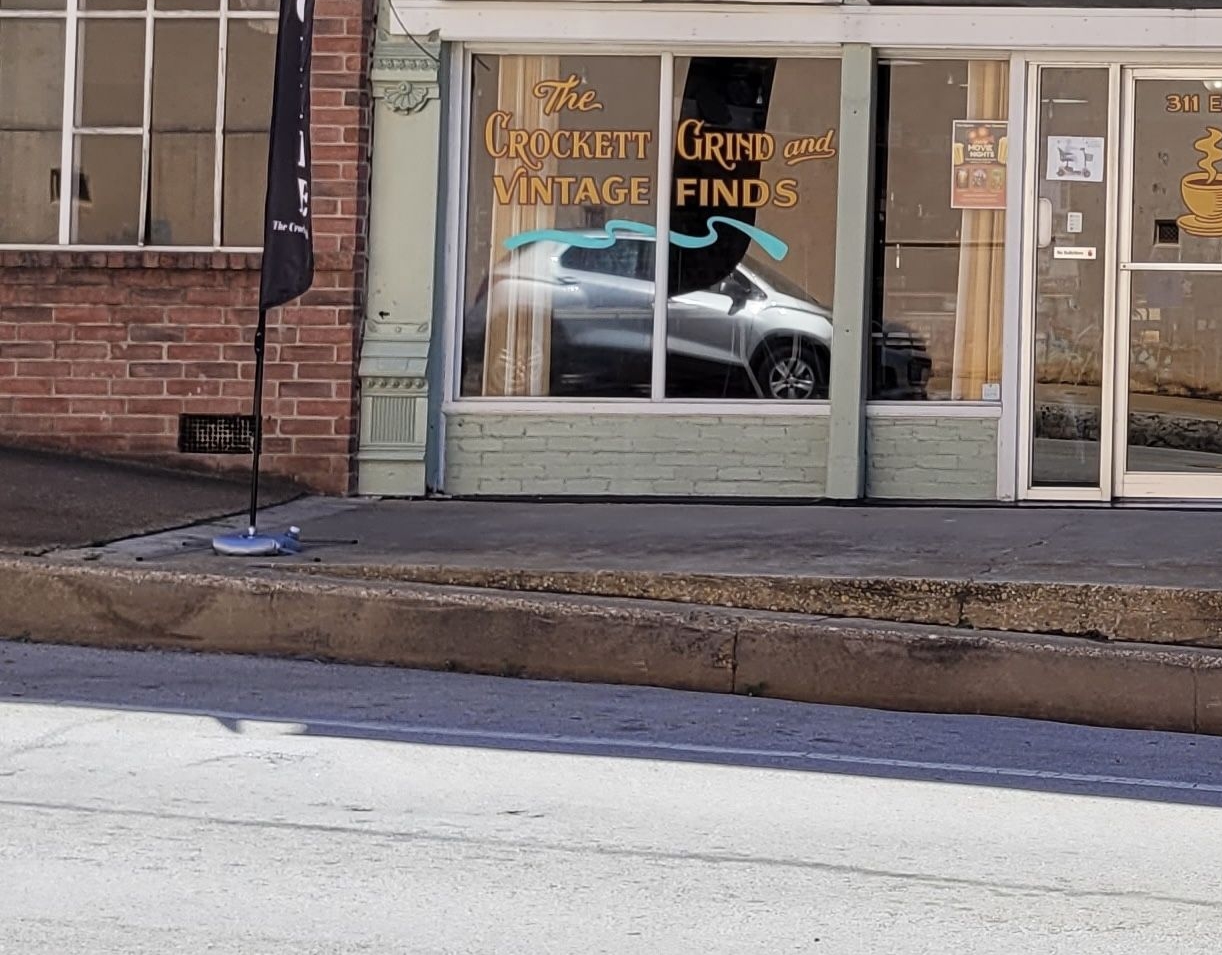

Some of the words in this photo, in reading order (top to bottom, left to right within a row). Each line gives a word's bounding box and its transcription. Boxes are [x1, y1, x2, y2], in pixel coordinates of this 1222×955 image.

[533, 75, 603, 115] The
[1166, 93, 1200, 113] 311
[484, 110, 652, 171] CROCKETT
[676, 118, 775, 171] GRIND
[783, 129, 837, 166] and
[493, 167, 651, 206] VINTAGE
[676, 178, 799, 208] FINDS
